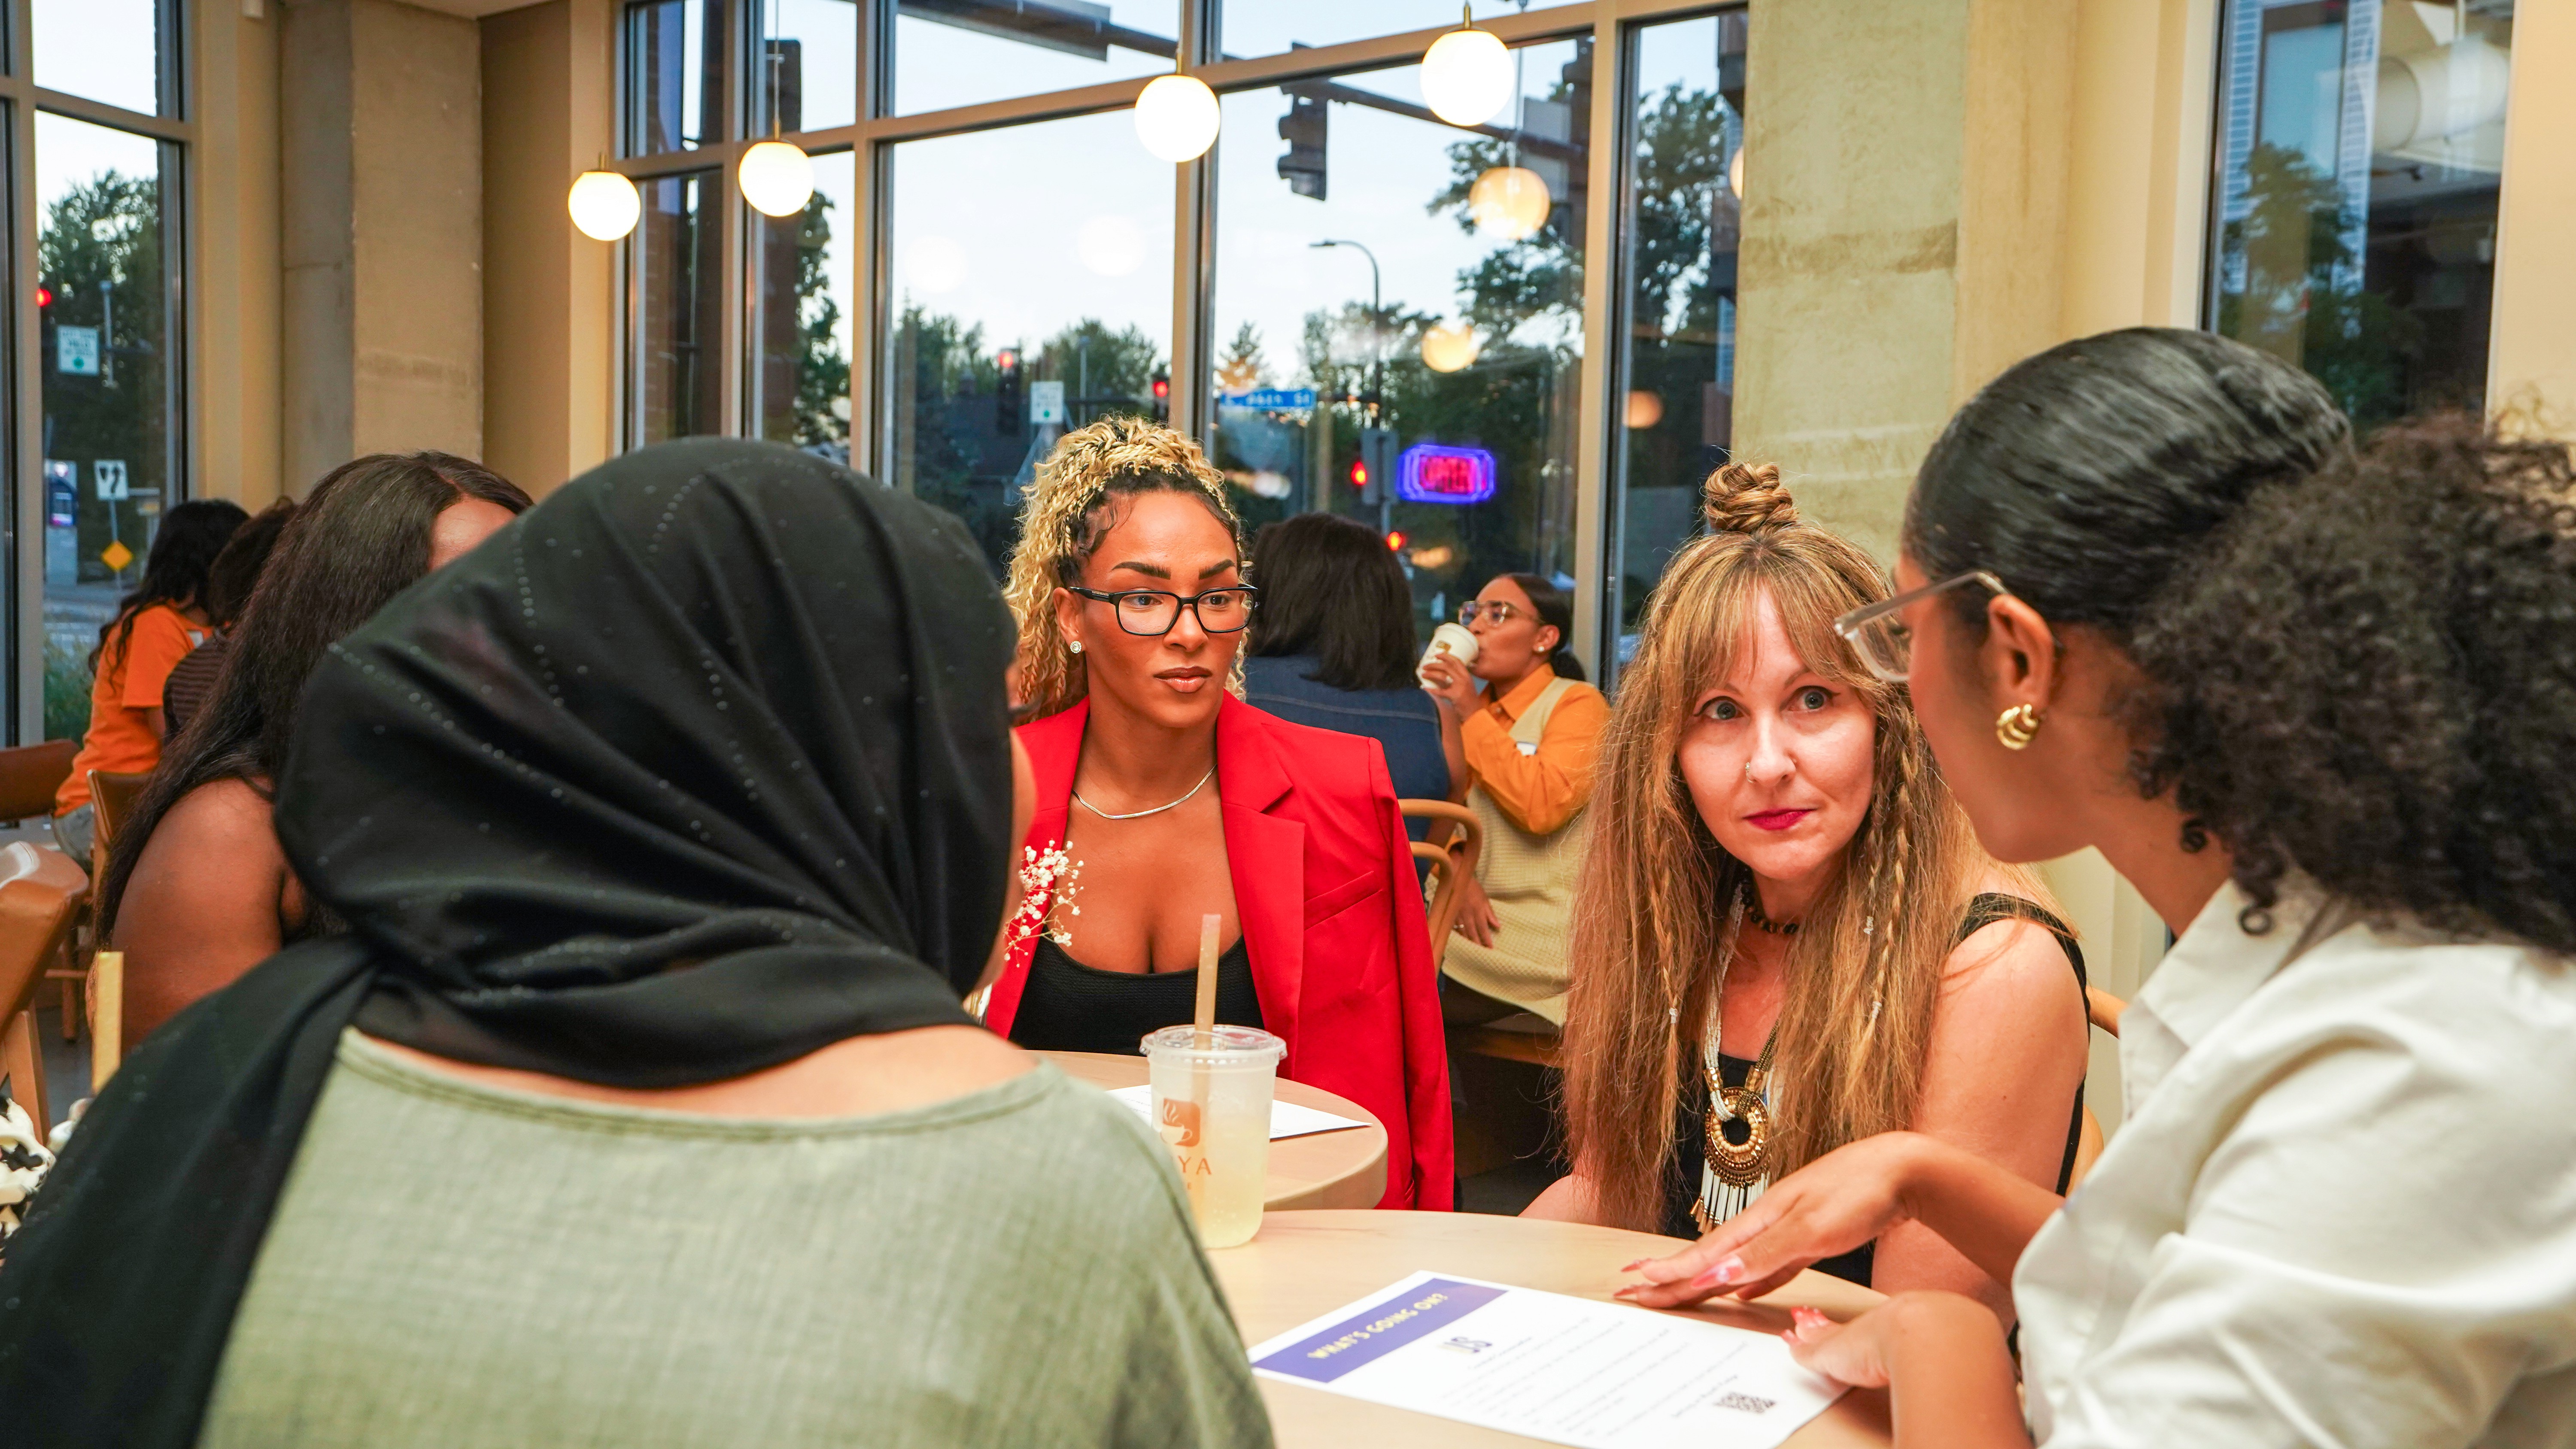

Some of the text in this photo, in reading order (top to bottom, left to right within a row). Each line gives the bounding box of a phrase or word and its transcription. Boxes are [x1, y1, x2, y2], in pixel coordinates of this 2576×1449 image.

[1178, 1155, 1212, 1175] YA
[1307, 1293, 1448, 1359] WHAT'S GOING ON?
